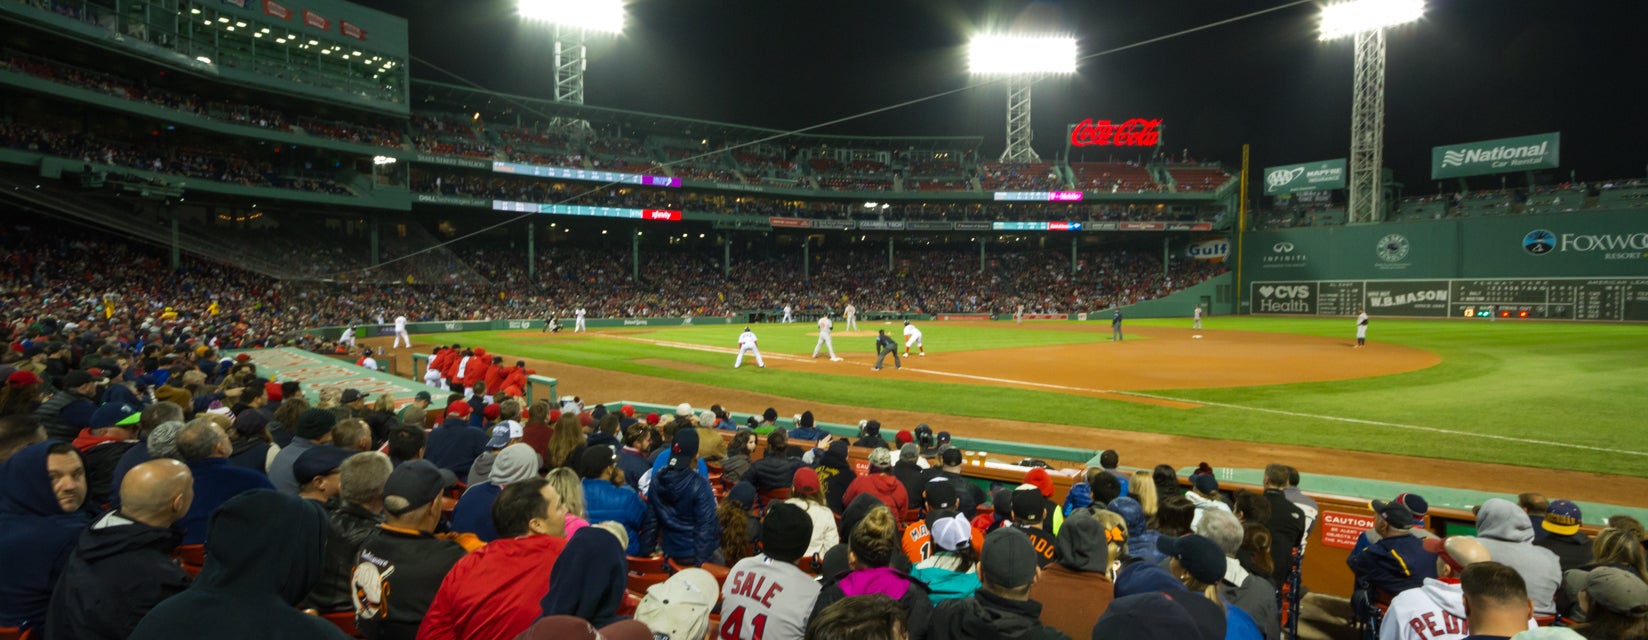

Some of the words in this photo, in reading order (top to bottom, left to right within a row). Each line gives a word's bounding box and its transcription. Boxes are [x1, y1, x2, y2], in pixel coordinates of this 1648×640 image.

[1464, 141, 1548, 163] National
[1188, 243, 1227, 256] Gulf
[1275, 285, 1310, 299] CVS
[1260, 299, 1309, 312] Health
[1324, 515, 1374, 528] CAUTION
[730, 570, 784, 609] SALE
[720, 605, 768, 640] 41
